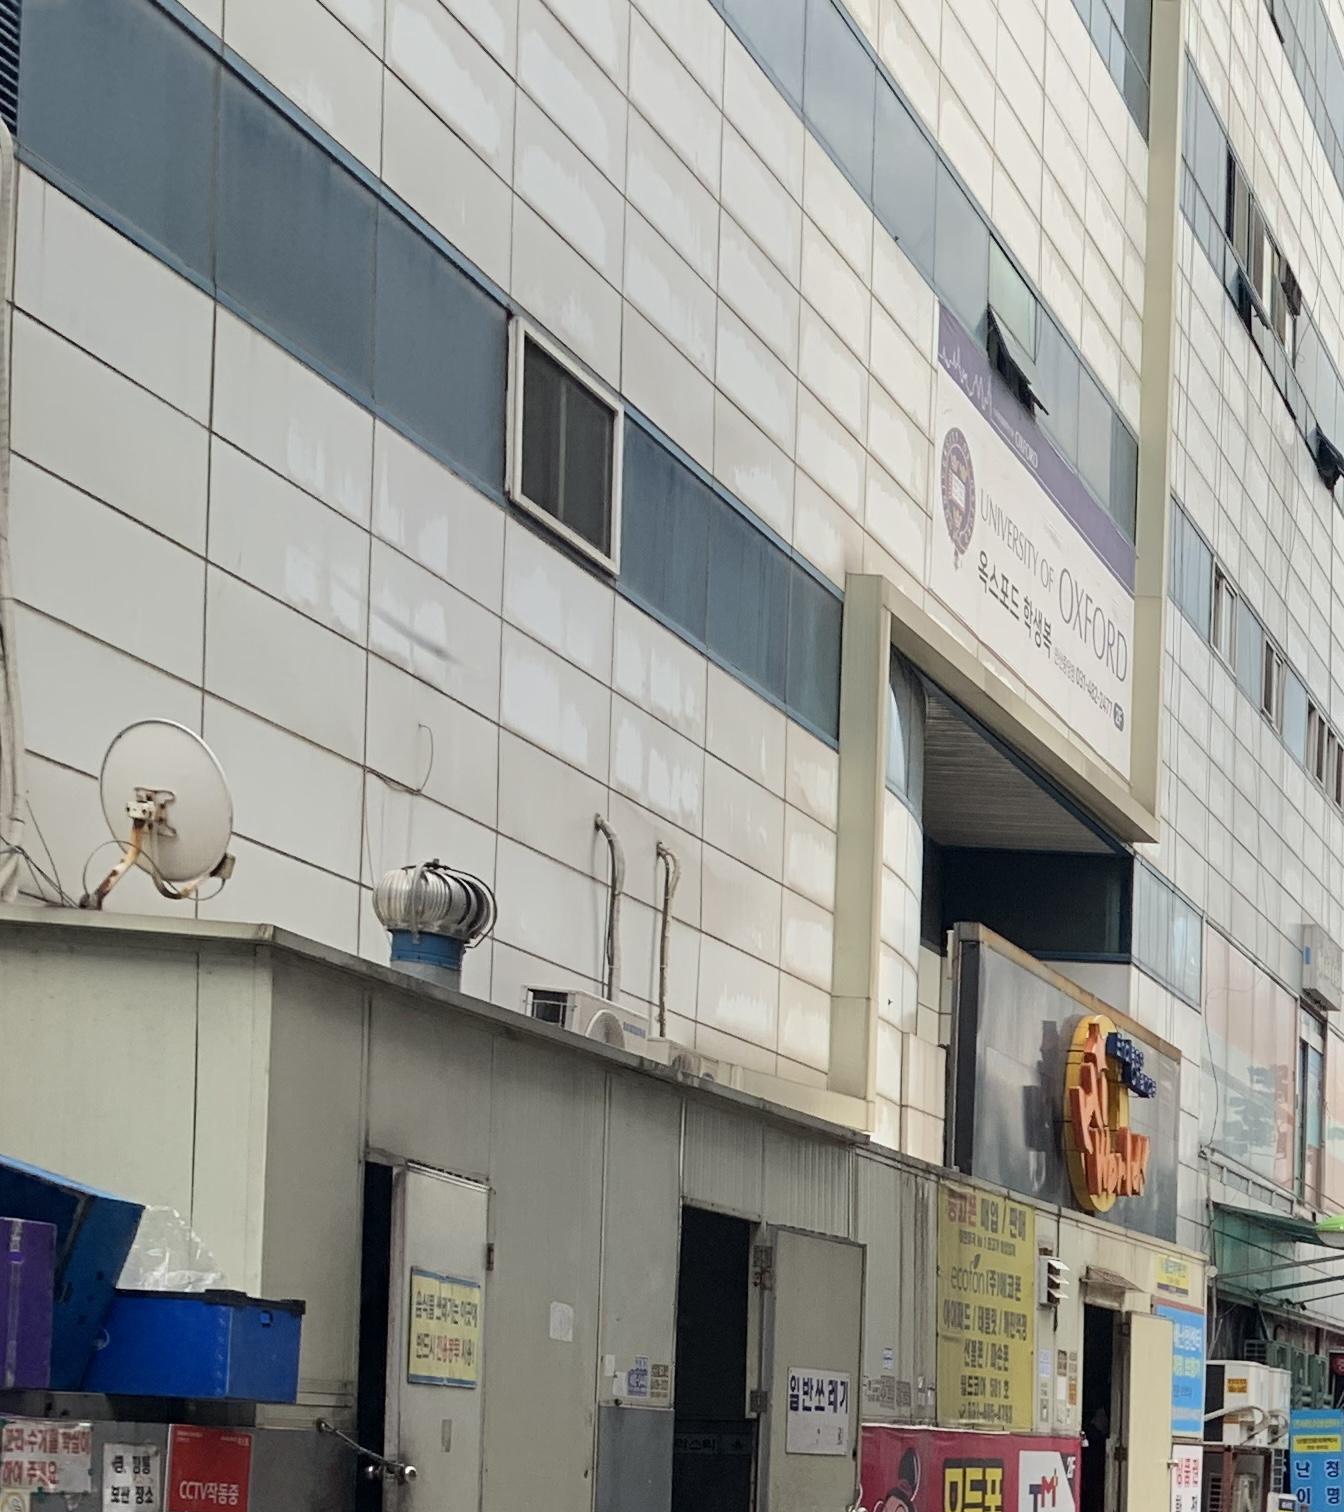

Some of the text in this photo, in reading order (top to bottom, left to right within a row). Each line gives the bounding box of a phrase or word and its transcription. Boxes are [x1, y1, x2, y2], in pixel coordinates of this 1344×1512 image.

[978, 549, 1054, 661] 옥스포드 학생복
[979, 487, 1128, 683] UNIVERSITY OF OXFORD
[789, 1375, 849, 1413] 일반쓰레기
[179, 1480, 239, 1505] CCTV작동중
